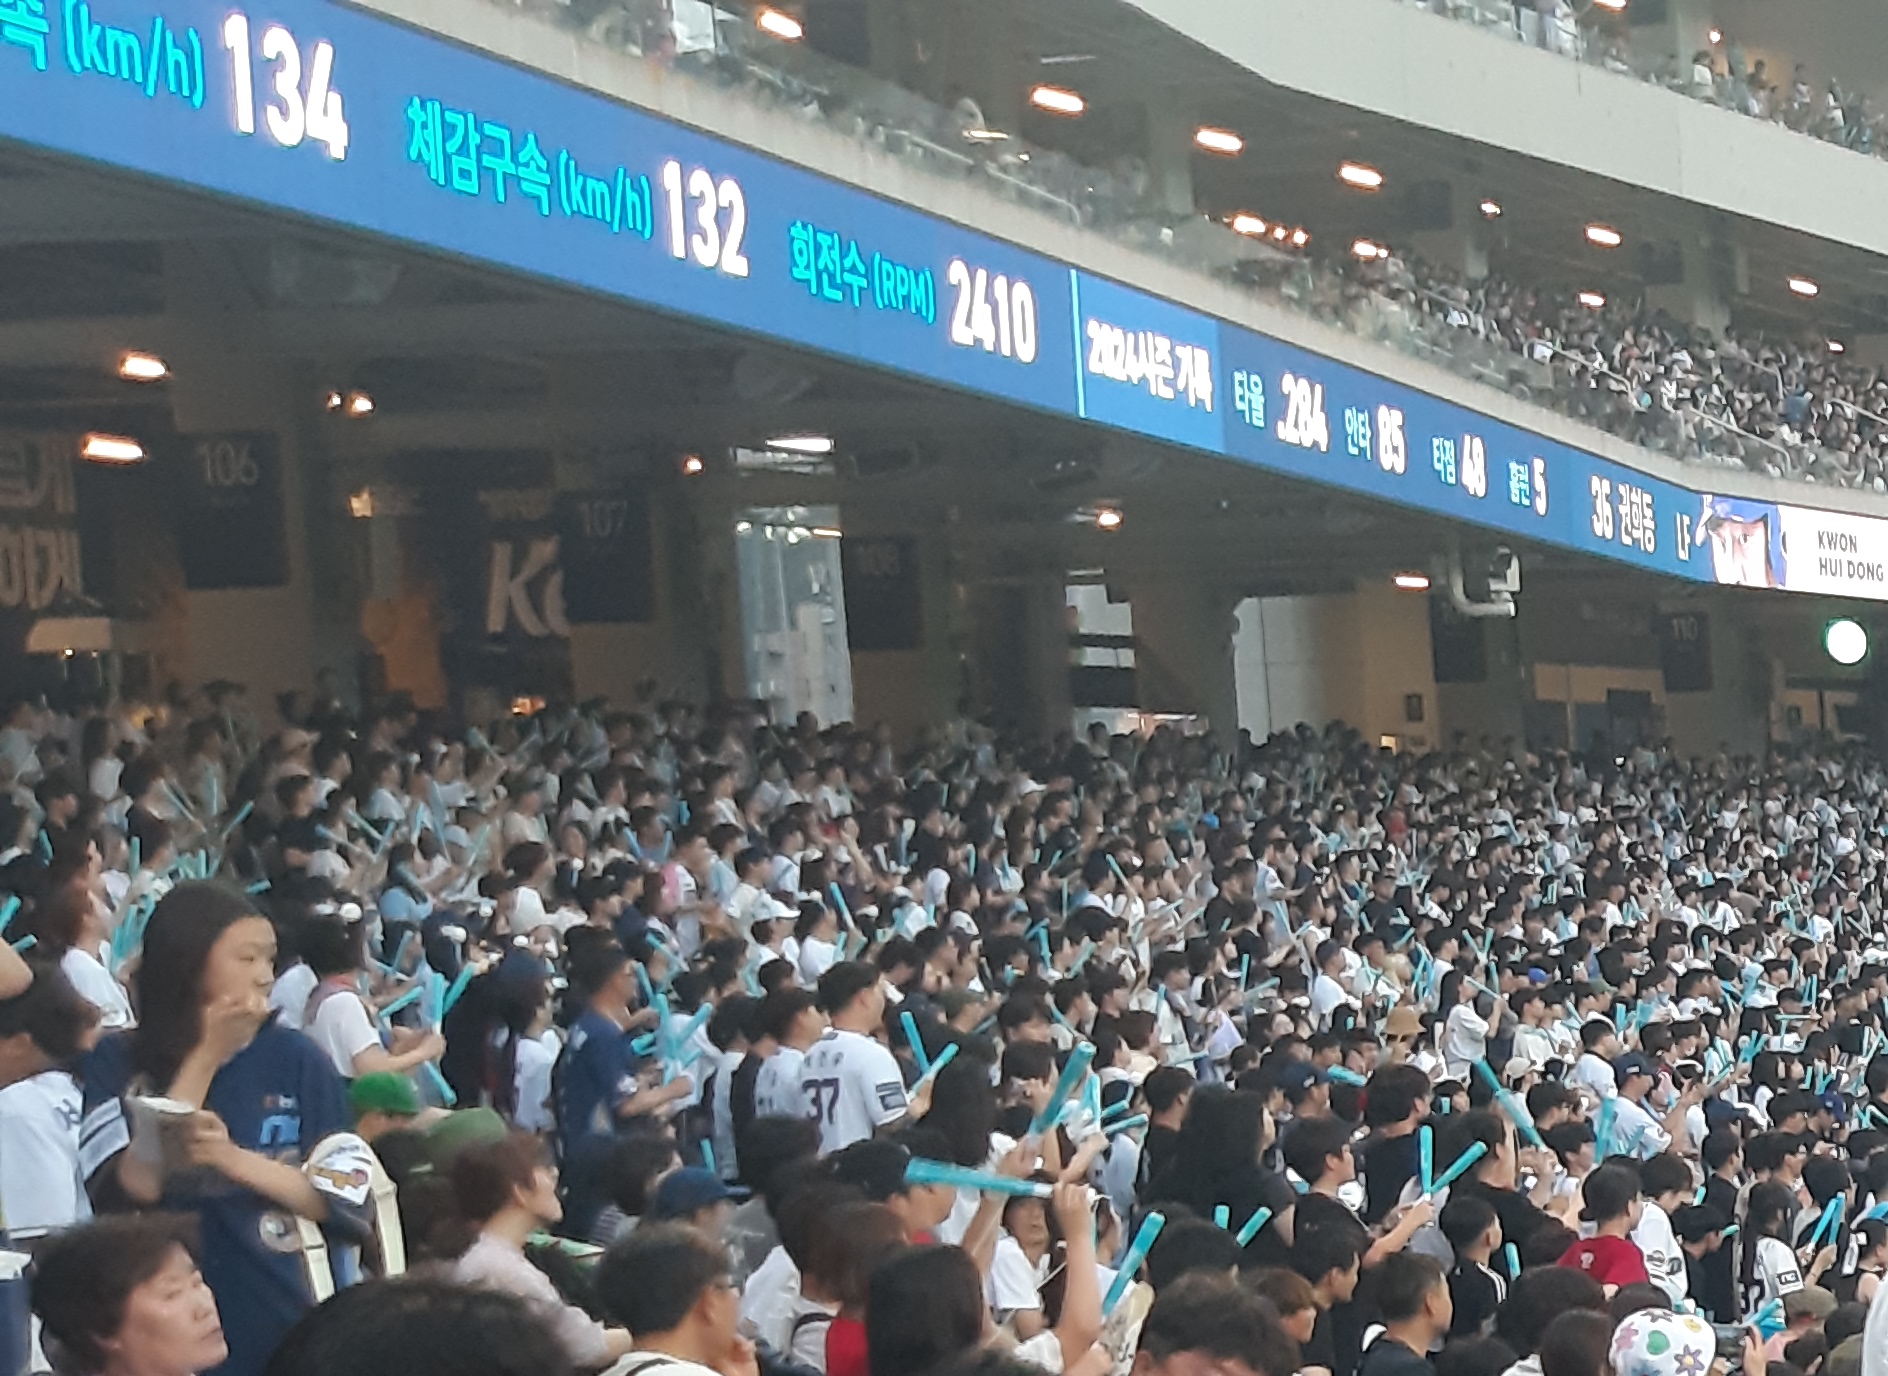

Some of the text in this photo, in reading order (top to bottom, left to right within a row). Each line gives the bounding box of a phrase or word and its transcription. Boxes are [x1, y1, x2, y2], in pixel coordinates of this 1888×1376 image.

[224, 10, 350, 162] 134
[406, 94, 655, 241] 체감구속 (km/h)
[662, 158, 750, 278] 132
[789, 219, 934, 324] 회전수 (RPM)
[947, 257, 1037, 364] 2410
[200, 441, 258, 487] 106
[1232, 369, 1265, 428] 타율
[1276, 371, 1328, 452] .284
[1344, 406, 1371, 460] 안타
[1377, 404, 1406, 475] 85
[1461, 434, 1487, 498] 48
[1533, 457, 1547, 516] 5
[1590, 475, 1691, 561] 36 권희동 LF
[1817, 530, 1858, 553] KWON
[1819, 557, 1884, 582] HUI DONG
[802, 1078, 839, 1124] 37
